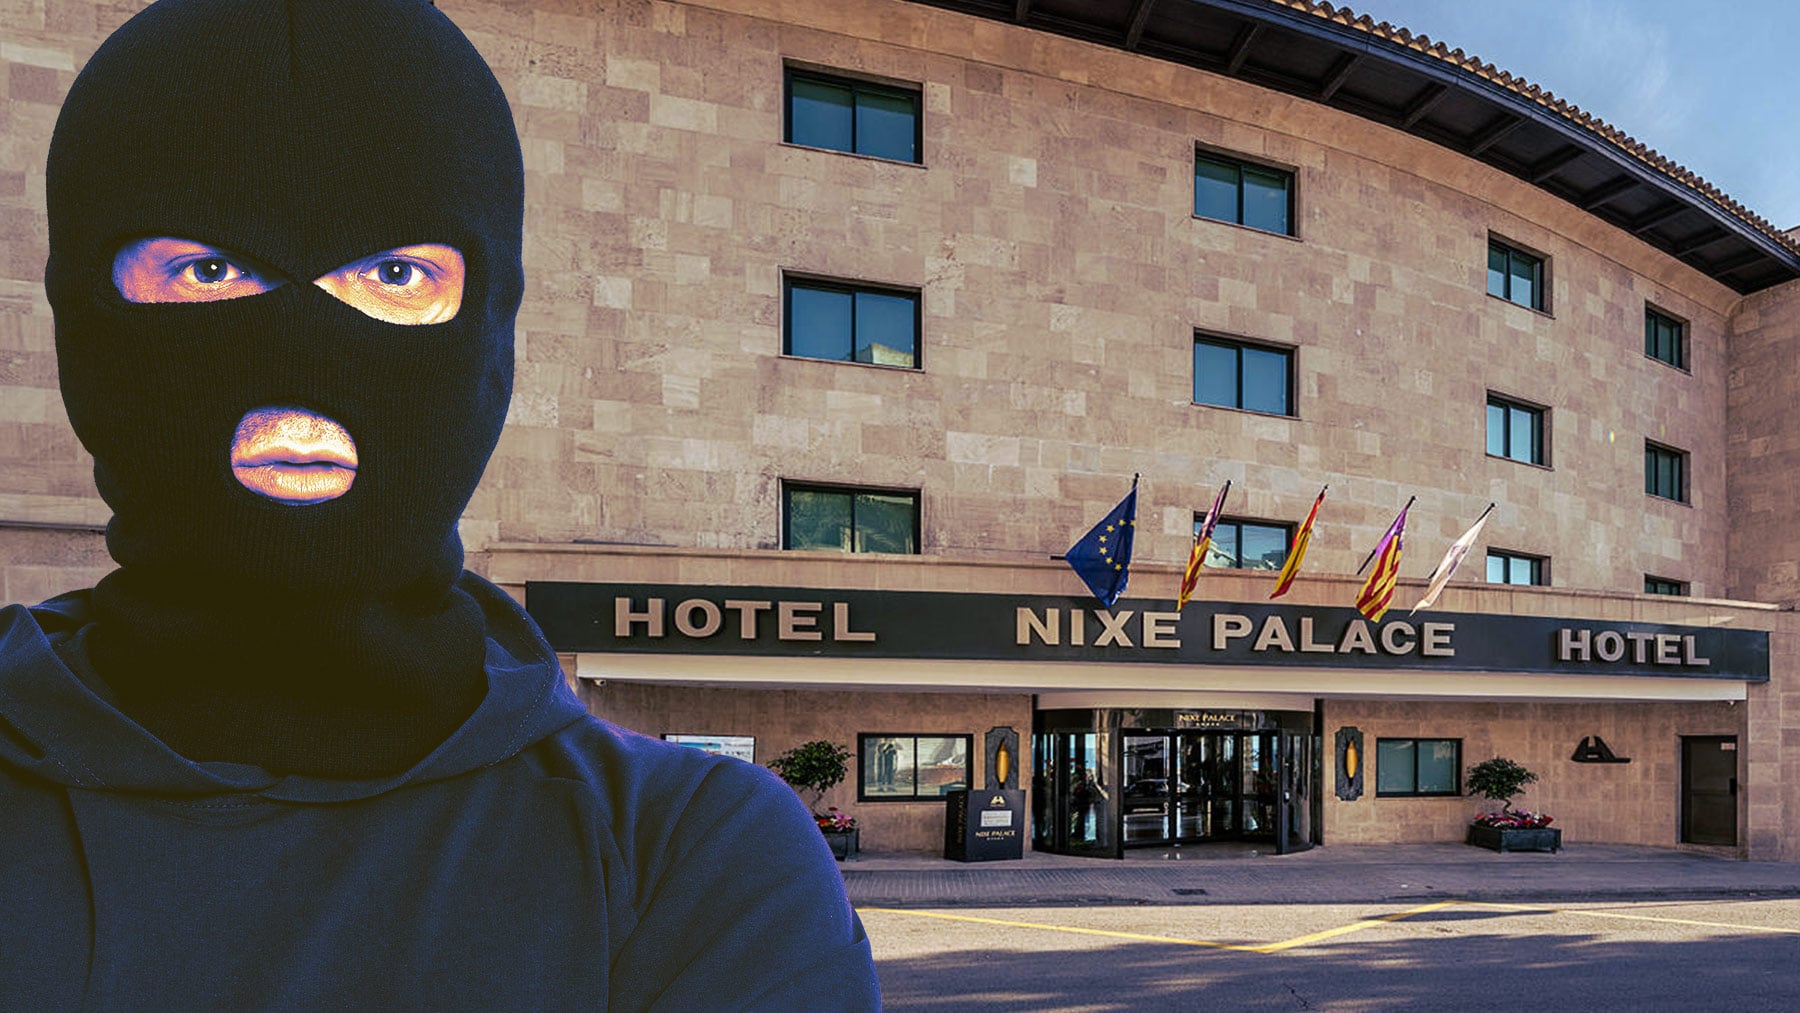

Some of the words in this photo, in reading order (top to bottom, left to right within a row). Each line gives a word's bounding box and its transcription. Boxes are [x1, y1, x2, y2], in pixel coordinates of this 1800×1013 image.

[614, 597, 876, 642] HOTEL
[1016, 606, 1182, 649] NIXE
[1212, 613, 1456, 657] PALACE
[1558, 628, 1710, 666] HOTEL
[1202, 713, 1235, 722] PALACE
